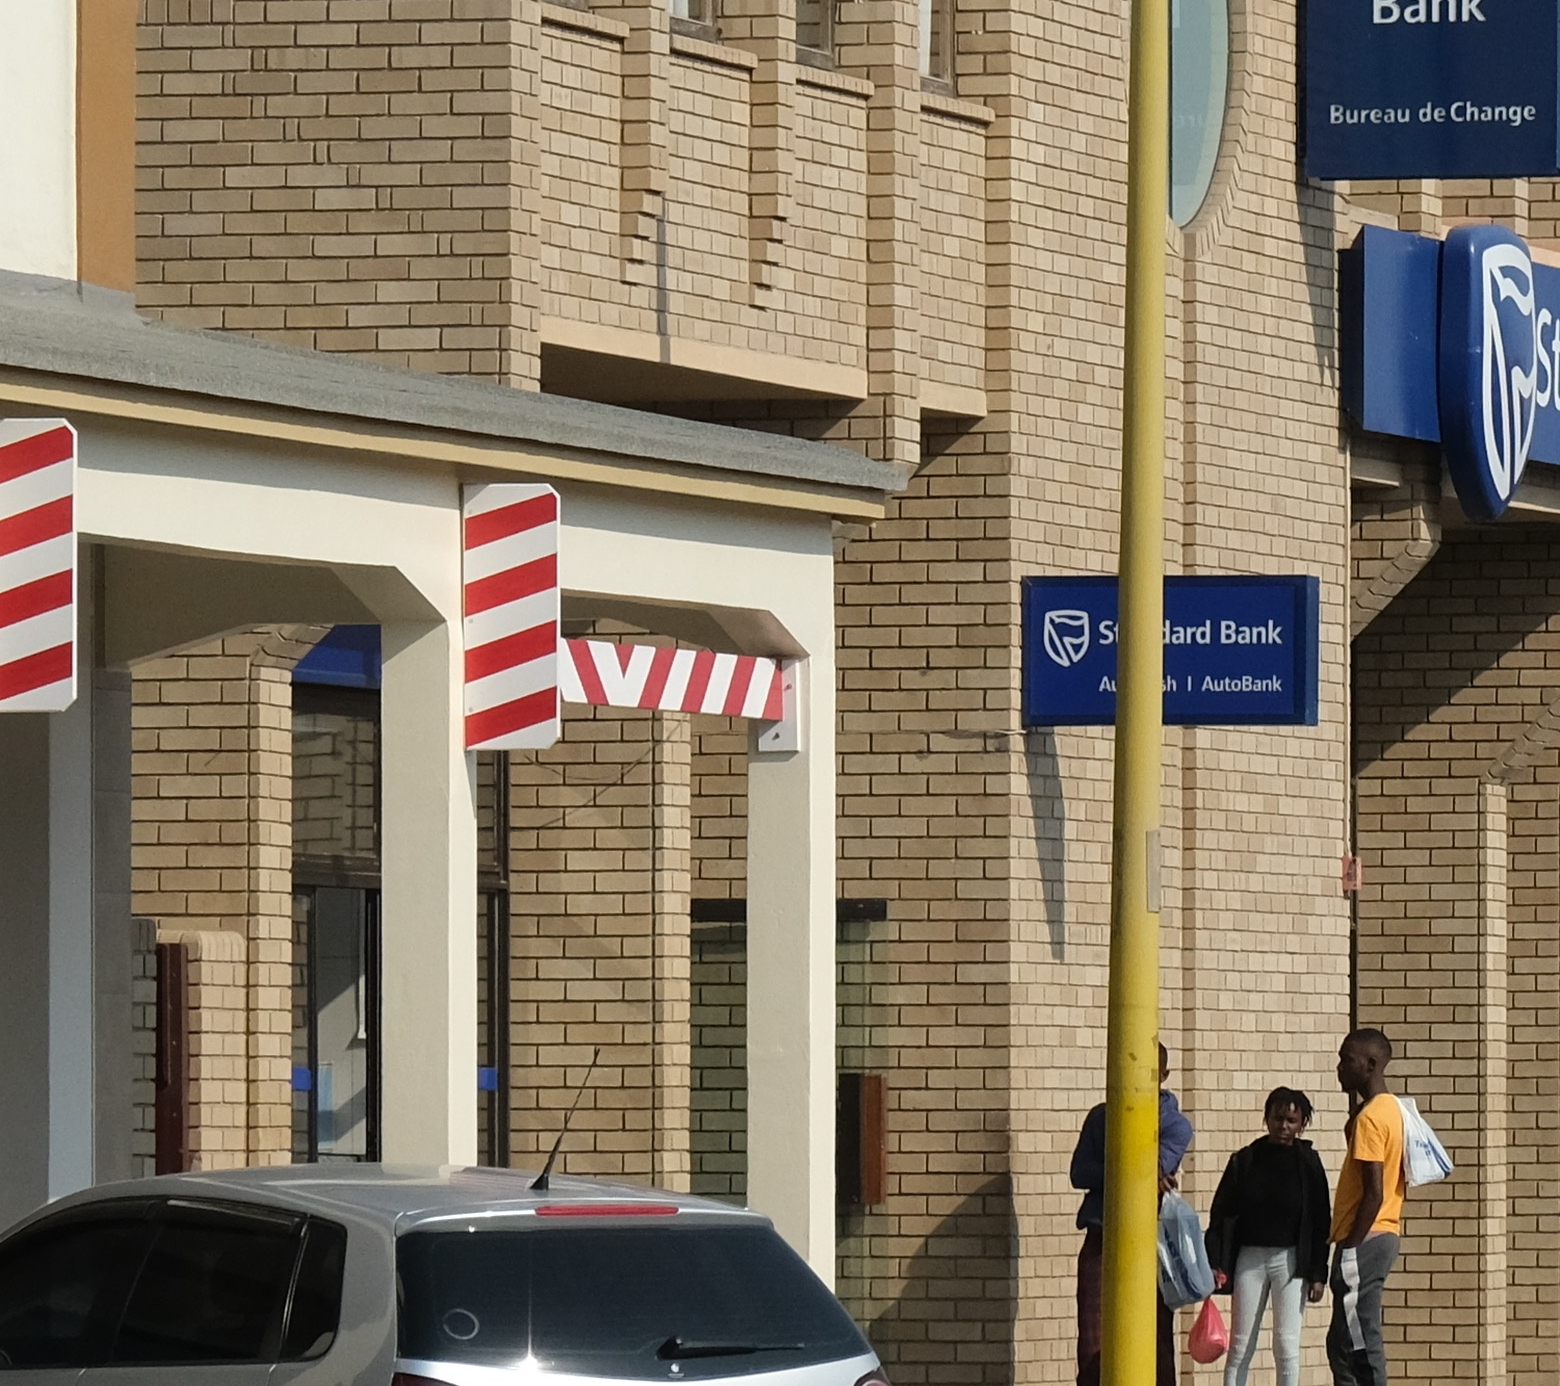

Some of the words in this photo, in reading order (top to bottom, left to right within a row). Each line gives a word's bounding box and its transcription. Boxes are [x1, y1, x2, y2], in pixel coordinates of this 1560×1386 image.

[1329, 103, 1411, 125] Bureau
[1418, 101, 1446, 123] de
[1449, 100, 1537, 127] Change
[1220, 618, 1283, 645] Bank
[1201, 674, 1283, 693] AutoBank
